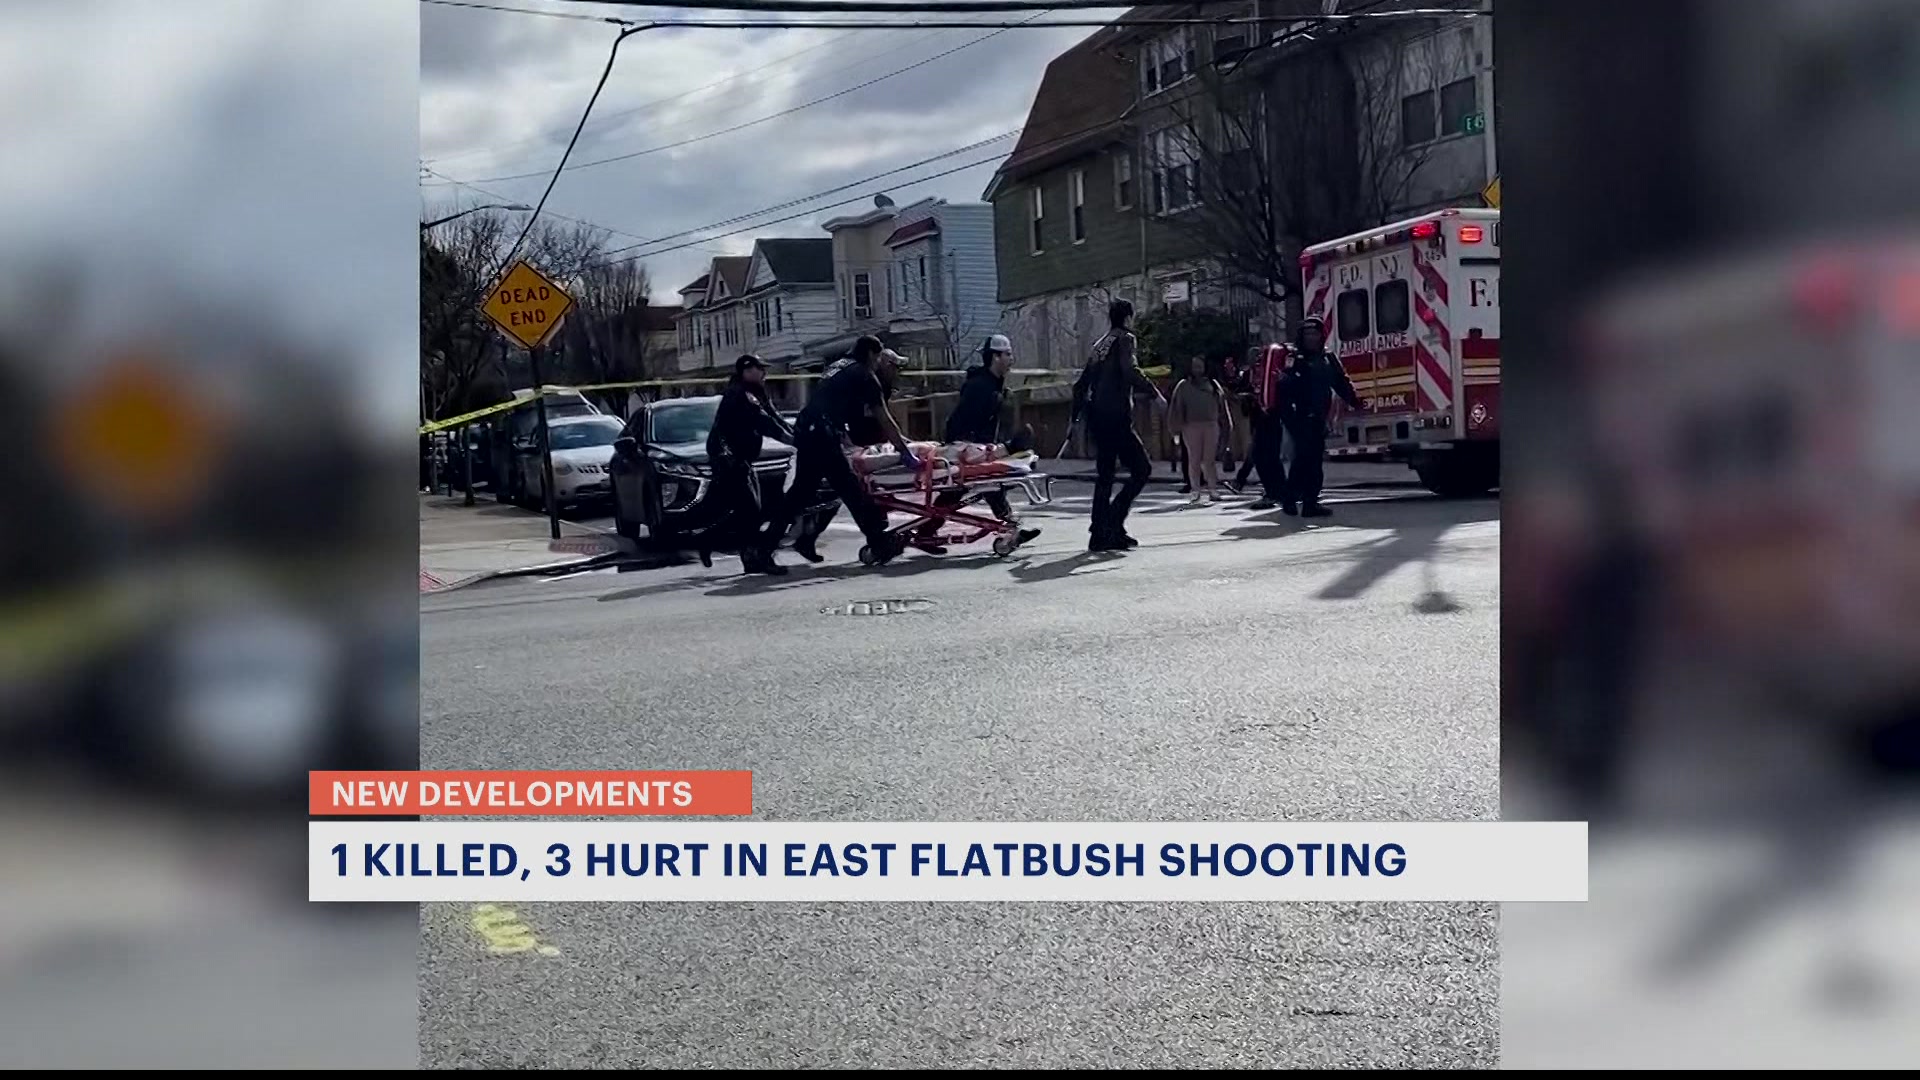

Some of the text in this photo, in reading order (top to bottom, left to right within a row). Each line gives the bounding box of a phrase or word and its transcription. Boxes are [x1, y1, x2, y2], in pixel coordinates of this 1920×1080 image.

[500, 286, 550, 305] DEAD
[1469, 278, 1500, 307] F.
[510, 308, 546, 327] END
[1340, 331, 1409, 355] AMBULANCE
[1377, 395, 1406, 408] BACK
